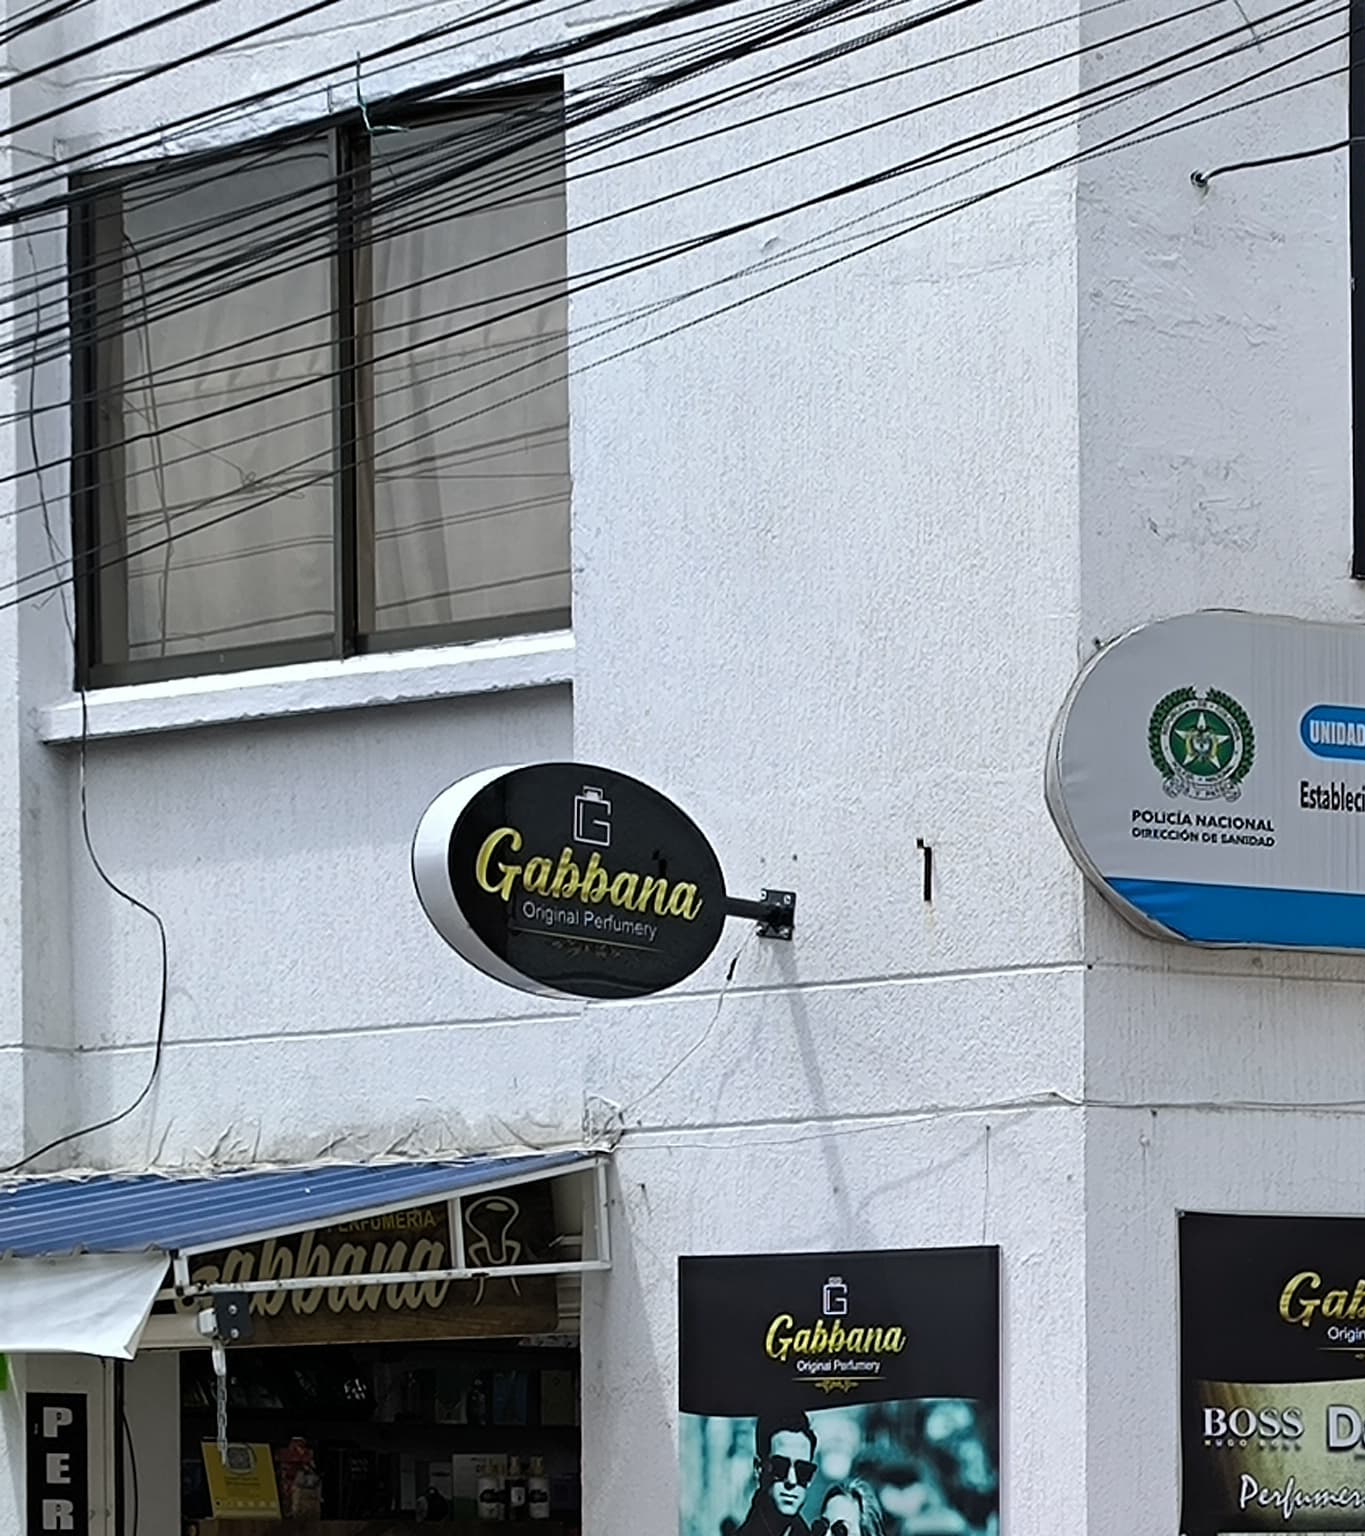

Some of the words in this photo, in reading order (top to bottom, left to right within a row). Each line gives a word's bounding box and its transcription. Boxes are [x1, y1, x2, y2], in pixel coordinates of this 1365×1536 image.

[1310, 719, 1365, 747] UNIDAD
[1131, 809, 1192, 826] POLICÍA
[1195, 815, 1275, 832] NACIONAL
[1201, 832, 1218, 844] DE
[1221, 834, 1275, 848] SANIDAD
[475, 827, 702, 921] Gabbana
[522, 900, 579, 929] Original
[583, 911, 658, 941] Perfumery
[765, 1314, 907, 1361] Gabbana
[796, 1359, 832, 1374] Original
[1203, 1406, 1304, 1438] BOSS
